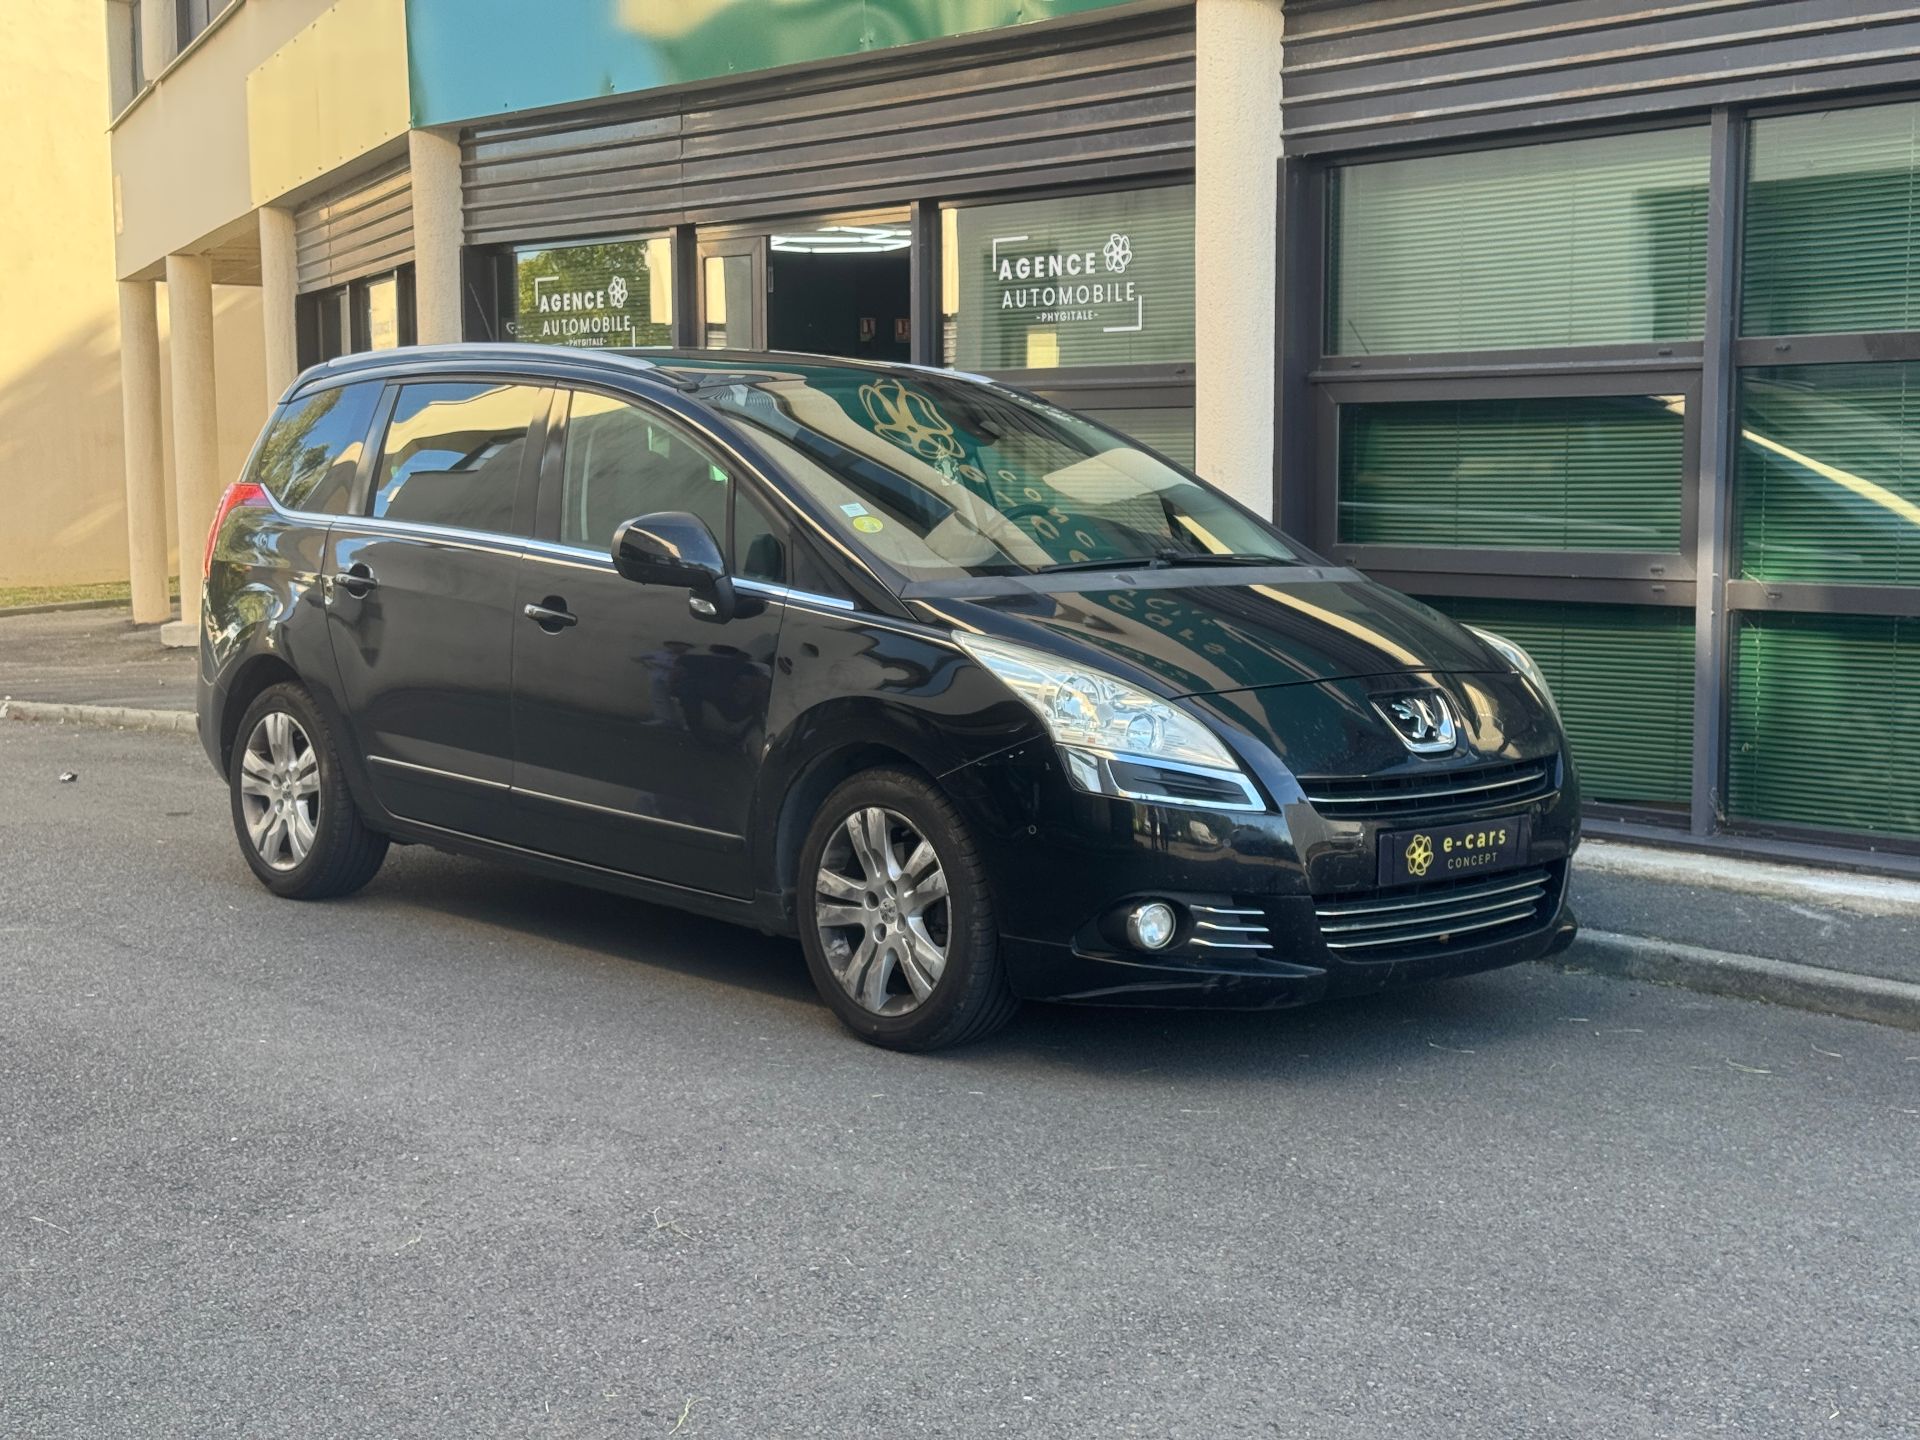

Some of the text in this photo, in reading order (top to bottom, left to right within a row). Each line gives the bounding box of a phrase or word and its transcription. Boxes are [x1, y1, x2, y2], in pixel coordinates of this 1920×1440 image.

[999, 252, 1096, 281] AGENCE
[539, 291, 605, 313] AGENCE
[1002, 282, 1136, 309] AUTOMOBILE
[542, 315, 631, 336] AUTOMOBILE
[1443, 828, 1506, 852] e-cars
[1447, 852, 1499, 869] CONCEPT
